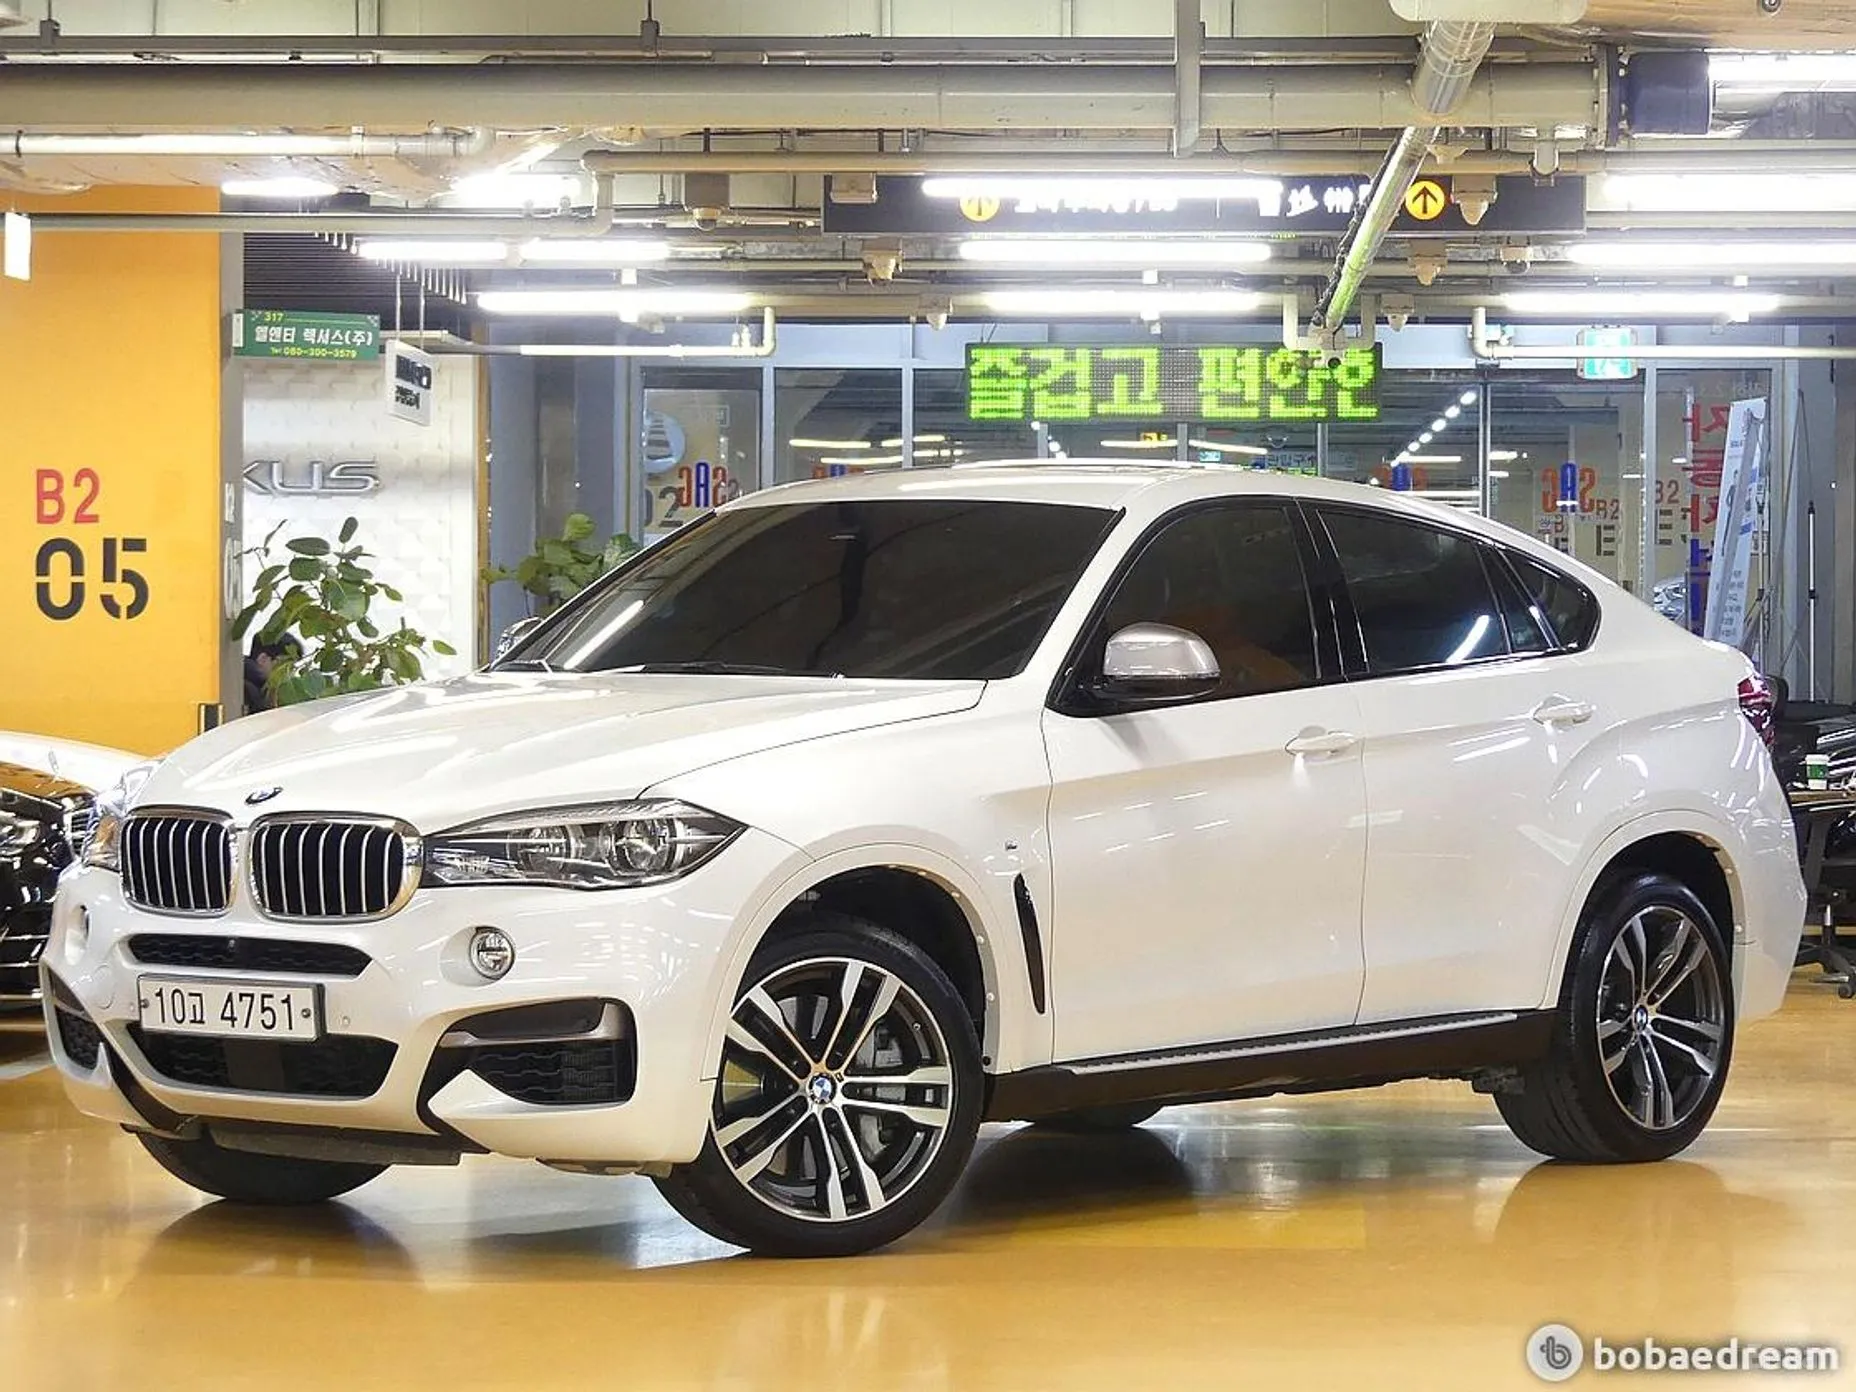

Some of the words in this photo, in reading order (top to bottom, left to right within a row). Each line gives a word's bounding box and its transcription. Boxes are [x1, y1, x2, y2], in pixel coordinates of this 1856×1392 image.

[264, 311, 284, 322] 317
[970, 347, 1163, 419] 즐겁고
[36, 467, 100, 524] B2
[35, 537, 149, 620] 05
[155, 987, 205, 1025] 10고
[220, 991, 293, 1030] 4751
